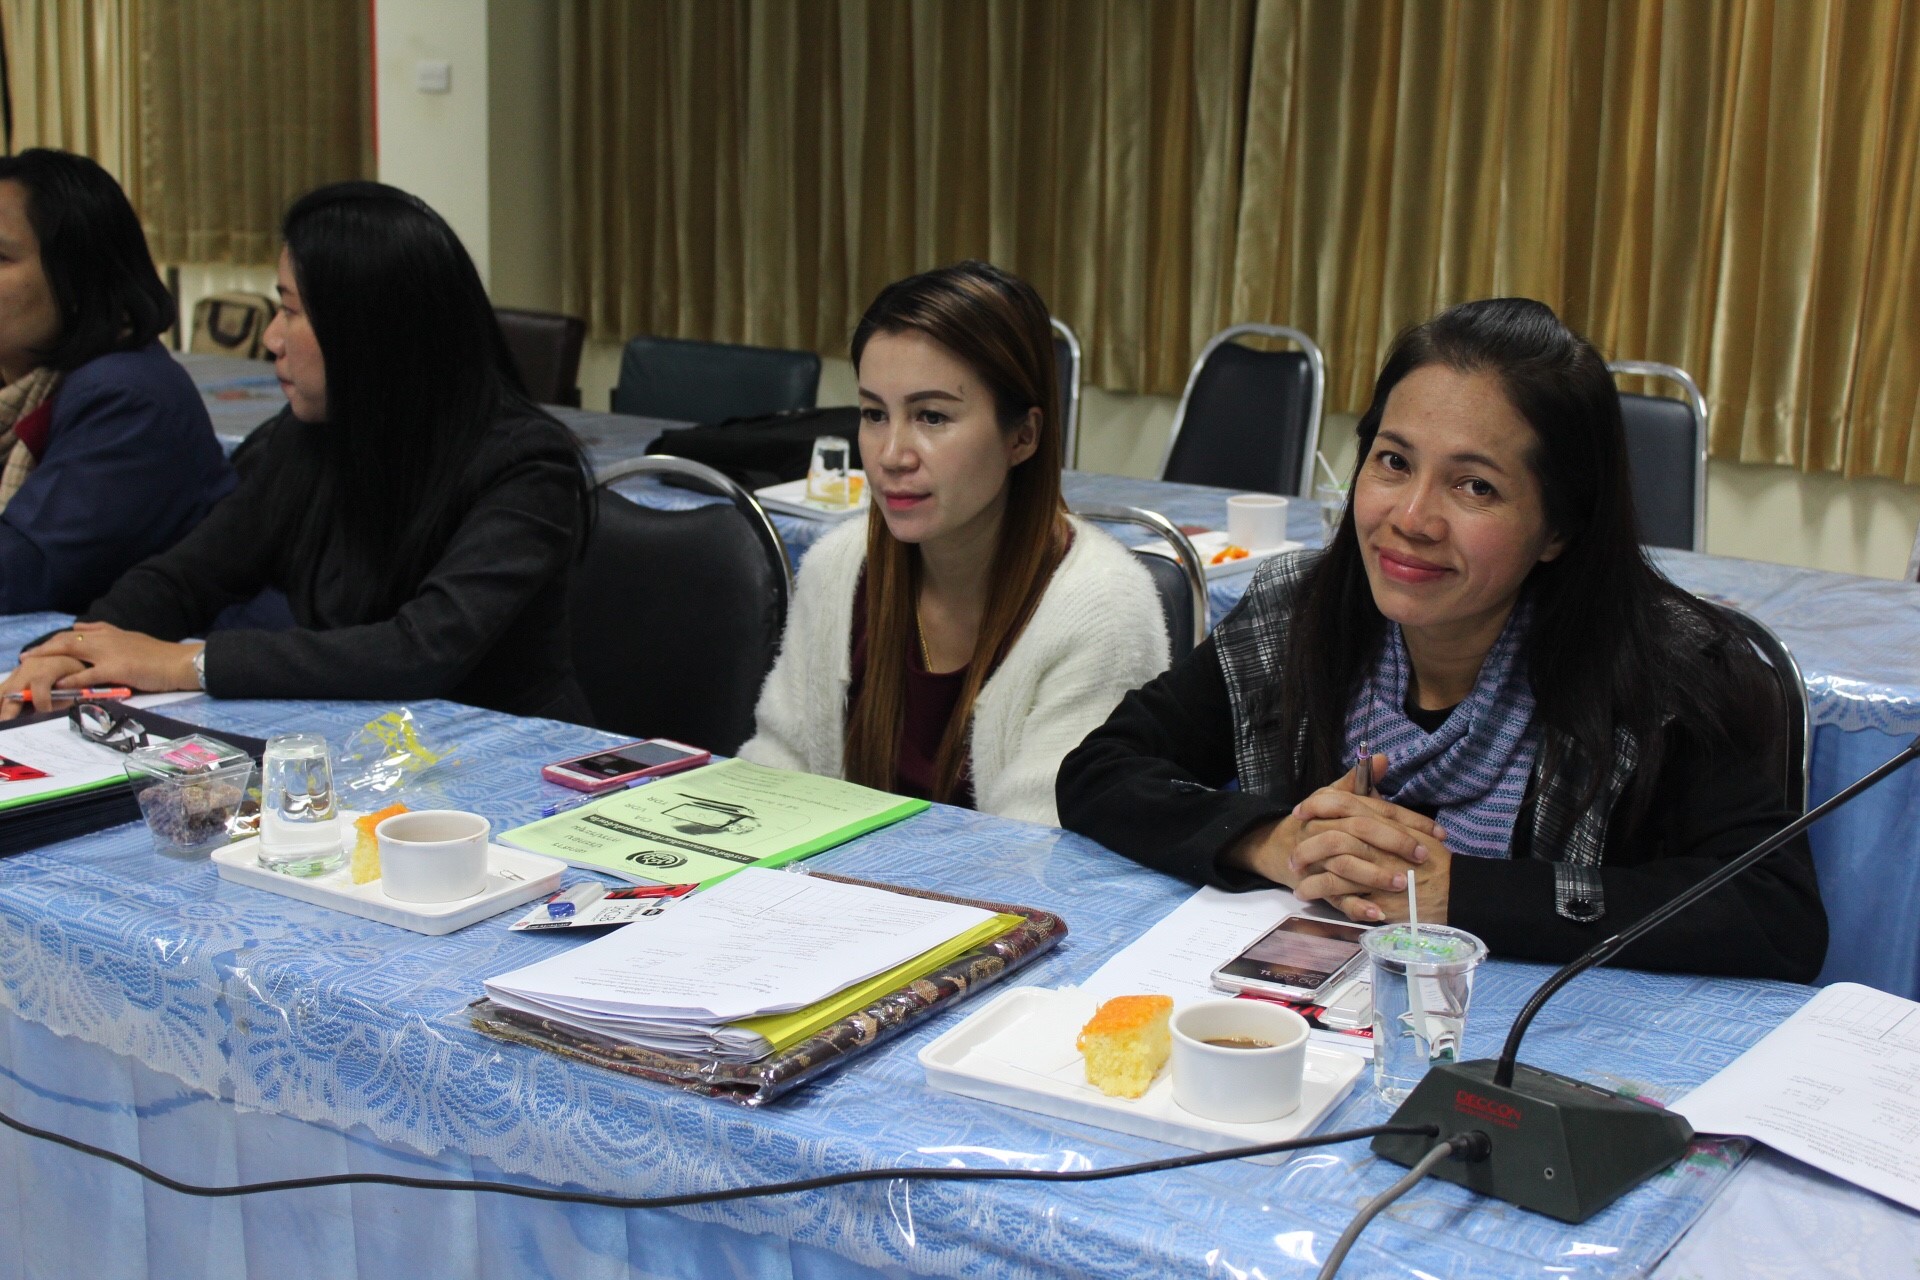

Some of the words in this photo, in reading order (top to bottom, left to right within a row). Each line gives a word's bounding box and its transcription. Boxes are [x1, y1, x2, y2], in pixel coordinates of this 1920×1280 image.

[564, 833, 604, 849] ประกอบ
[571, 824, 623, 843] การประชุม
[552, 841, 588, 854] เอกสาร
